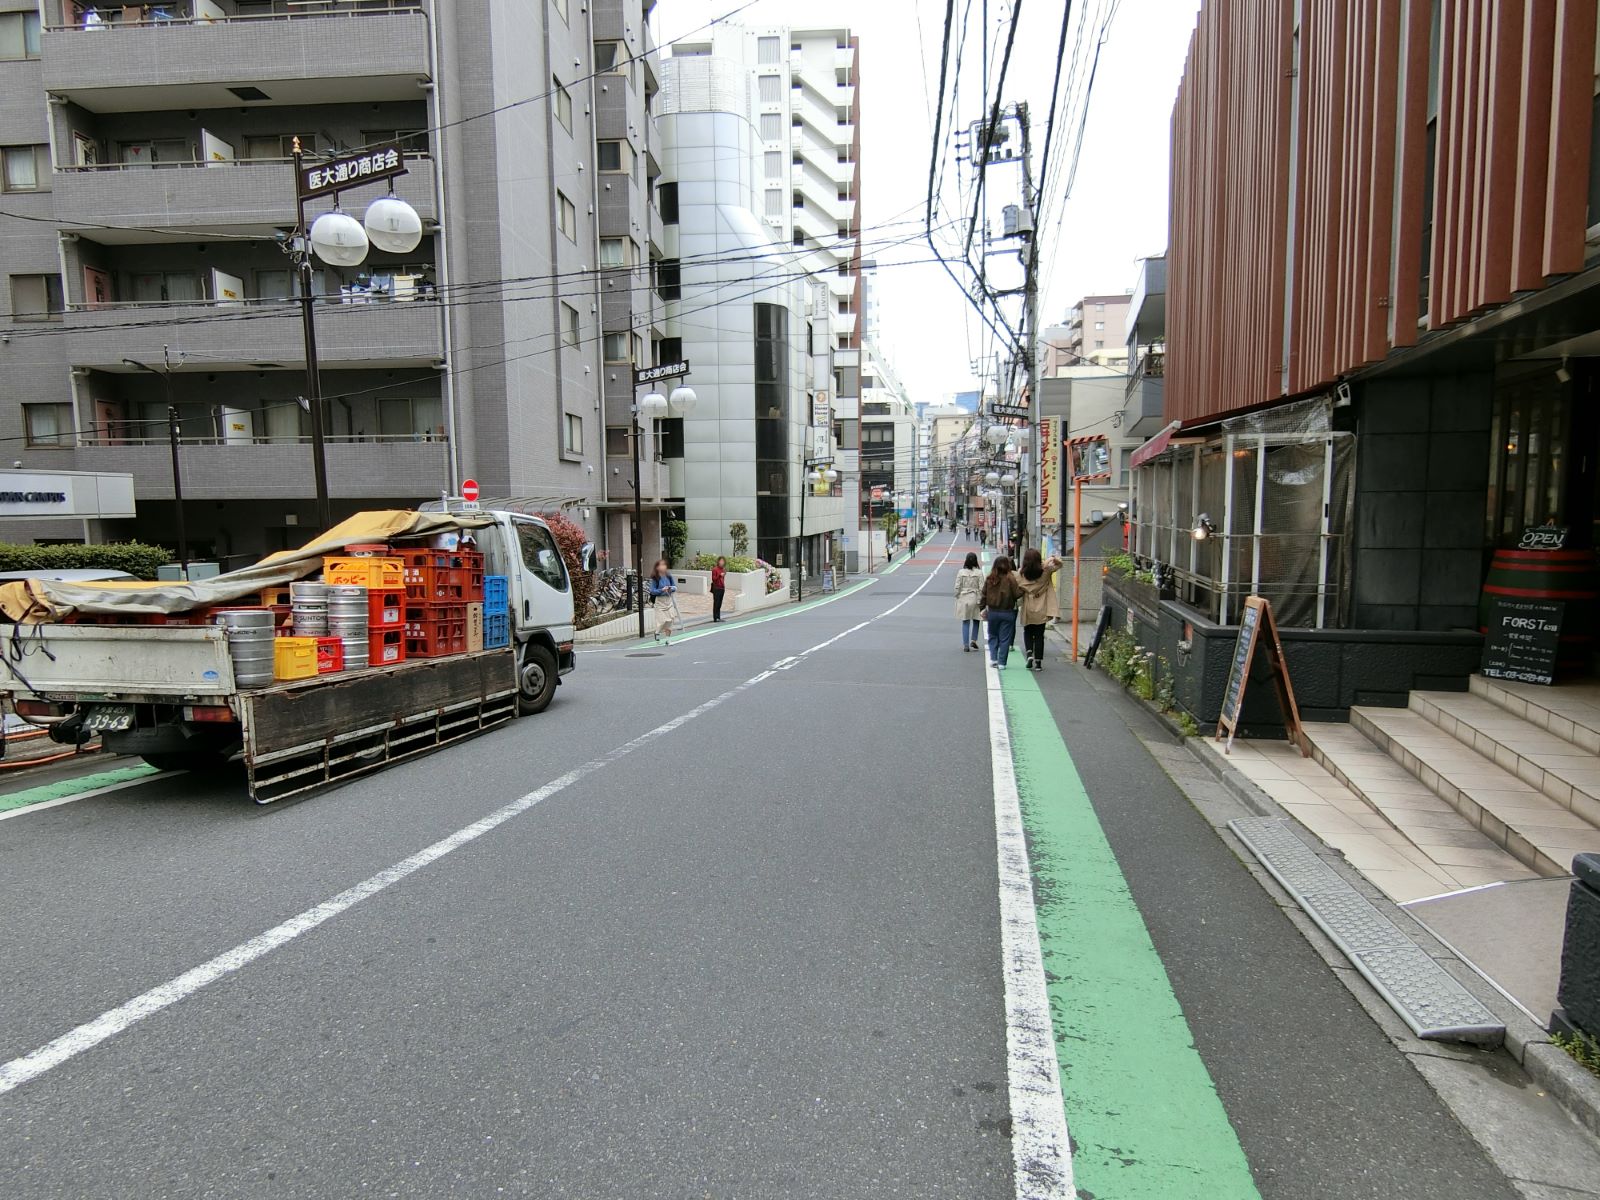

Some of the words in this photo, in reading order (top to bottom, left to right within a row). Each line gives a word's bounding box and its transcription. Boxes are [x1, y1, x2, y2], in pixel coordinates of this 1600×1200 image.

[309, 149, 398, 189] 医大通り商店会
[1522, 532, 1565, 546] OPEN
[333, 575, 367, 585] ホッピー
[1502, 616, 1547, 630] FORST
[90, 715, 130, 729] 39-69
